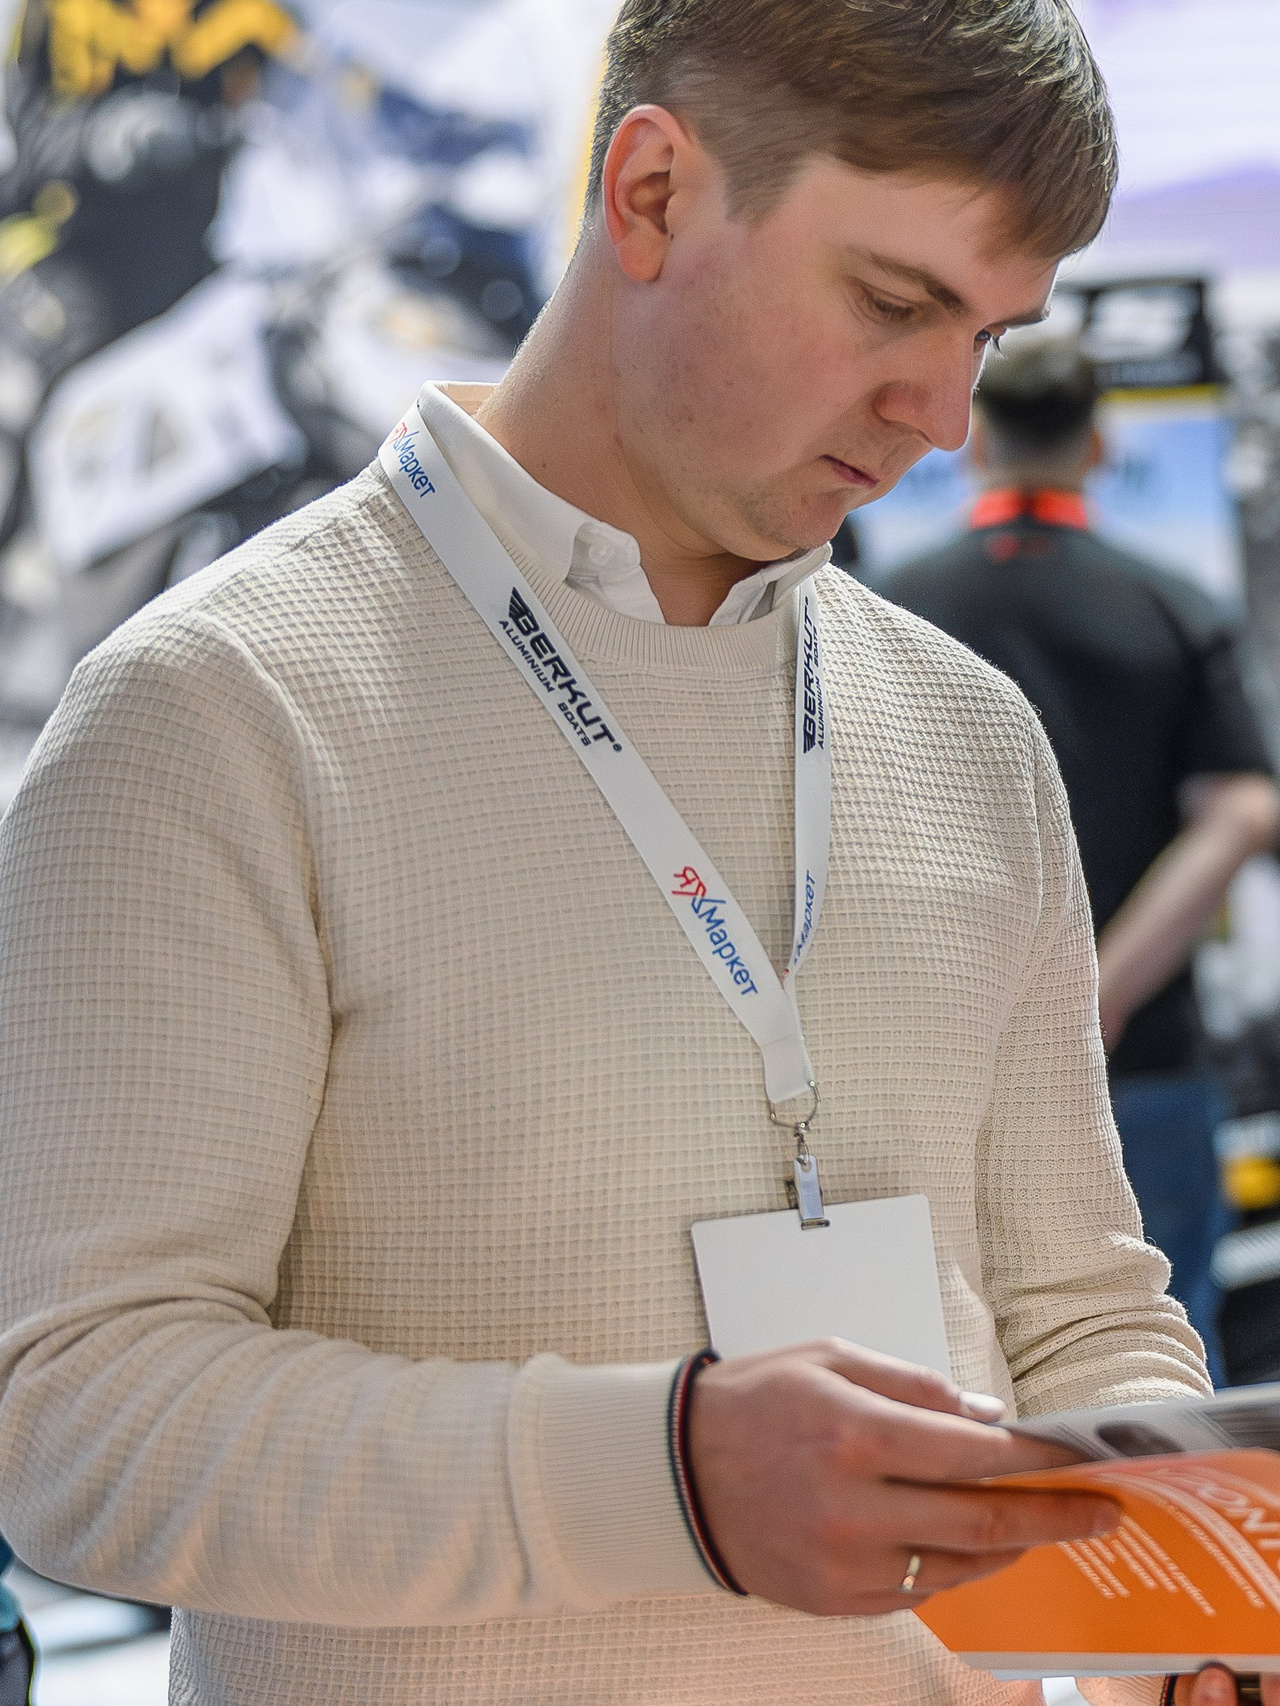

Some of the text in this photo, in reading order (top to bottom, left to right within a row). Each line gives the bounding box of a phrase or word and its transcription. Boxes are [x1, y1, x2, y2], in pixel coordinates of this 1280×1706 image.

[499, 619, 592, 746] ALUMINIUM BOATS
[814, 676, 825, 750] ALUMINIUM
